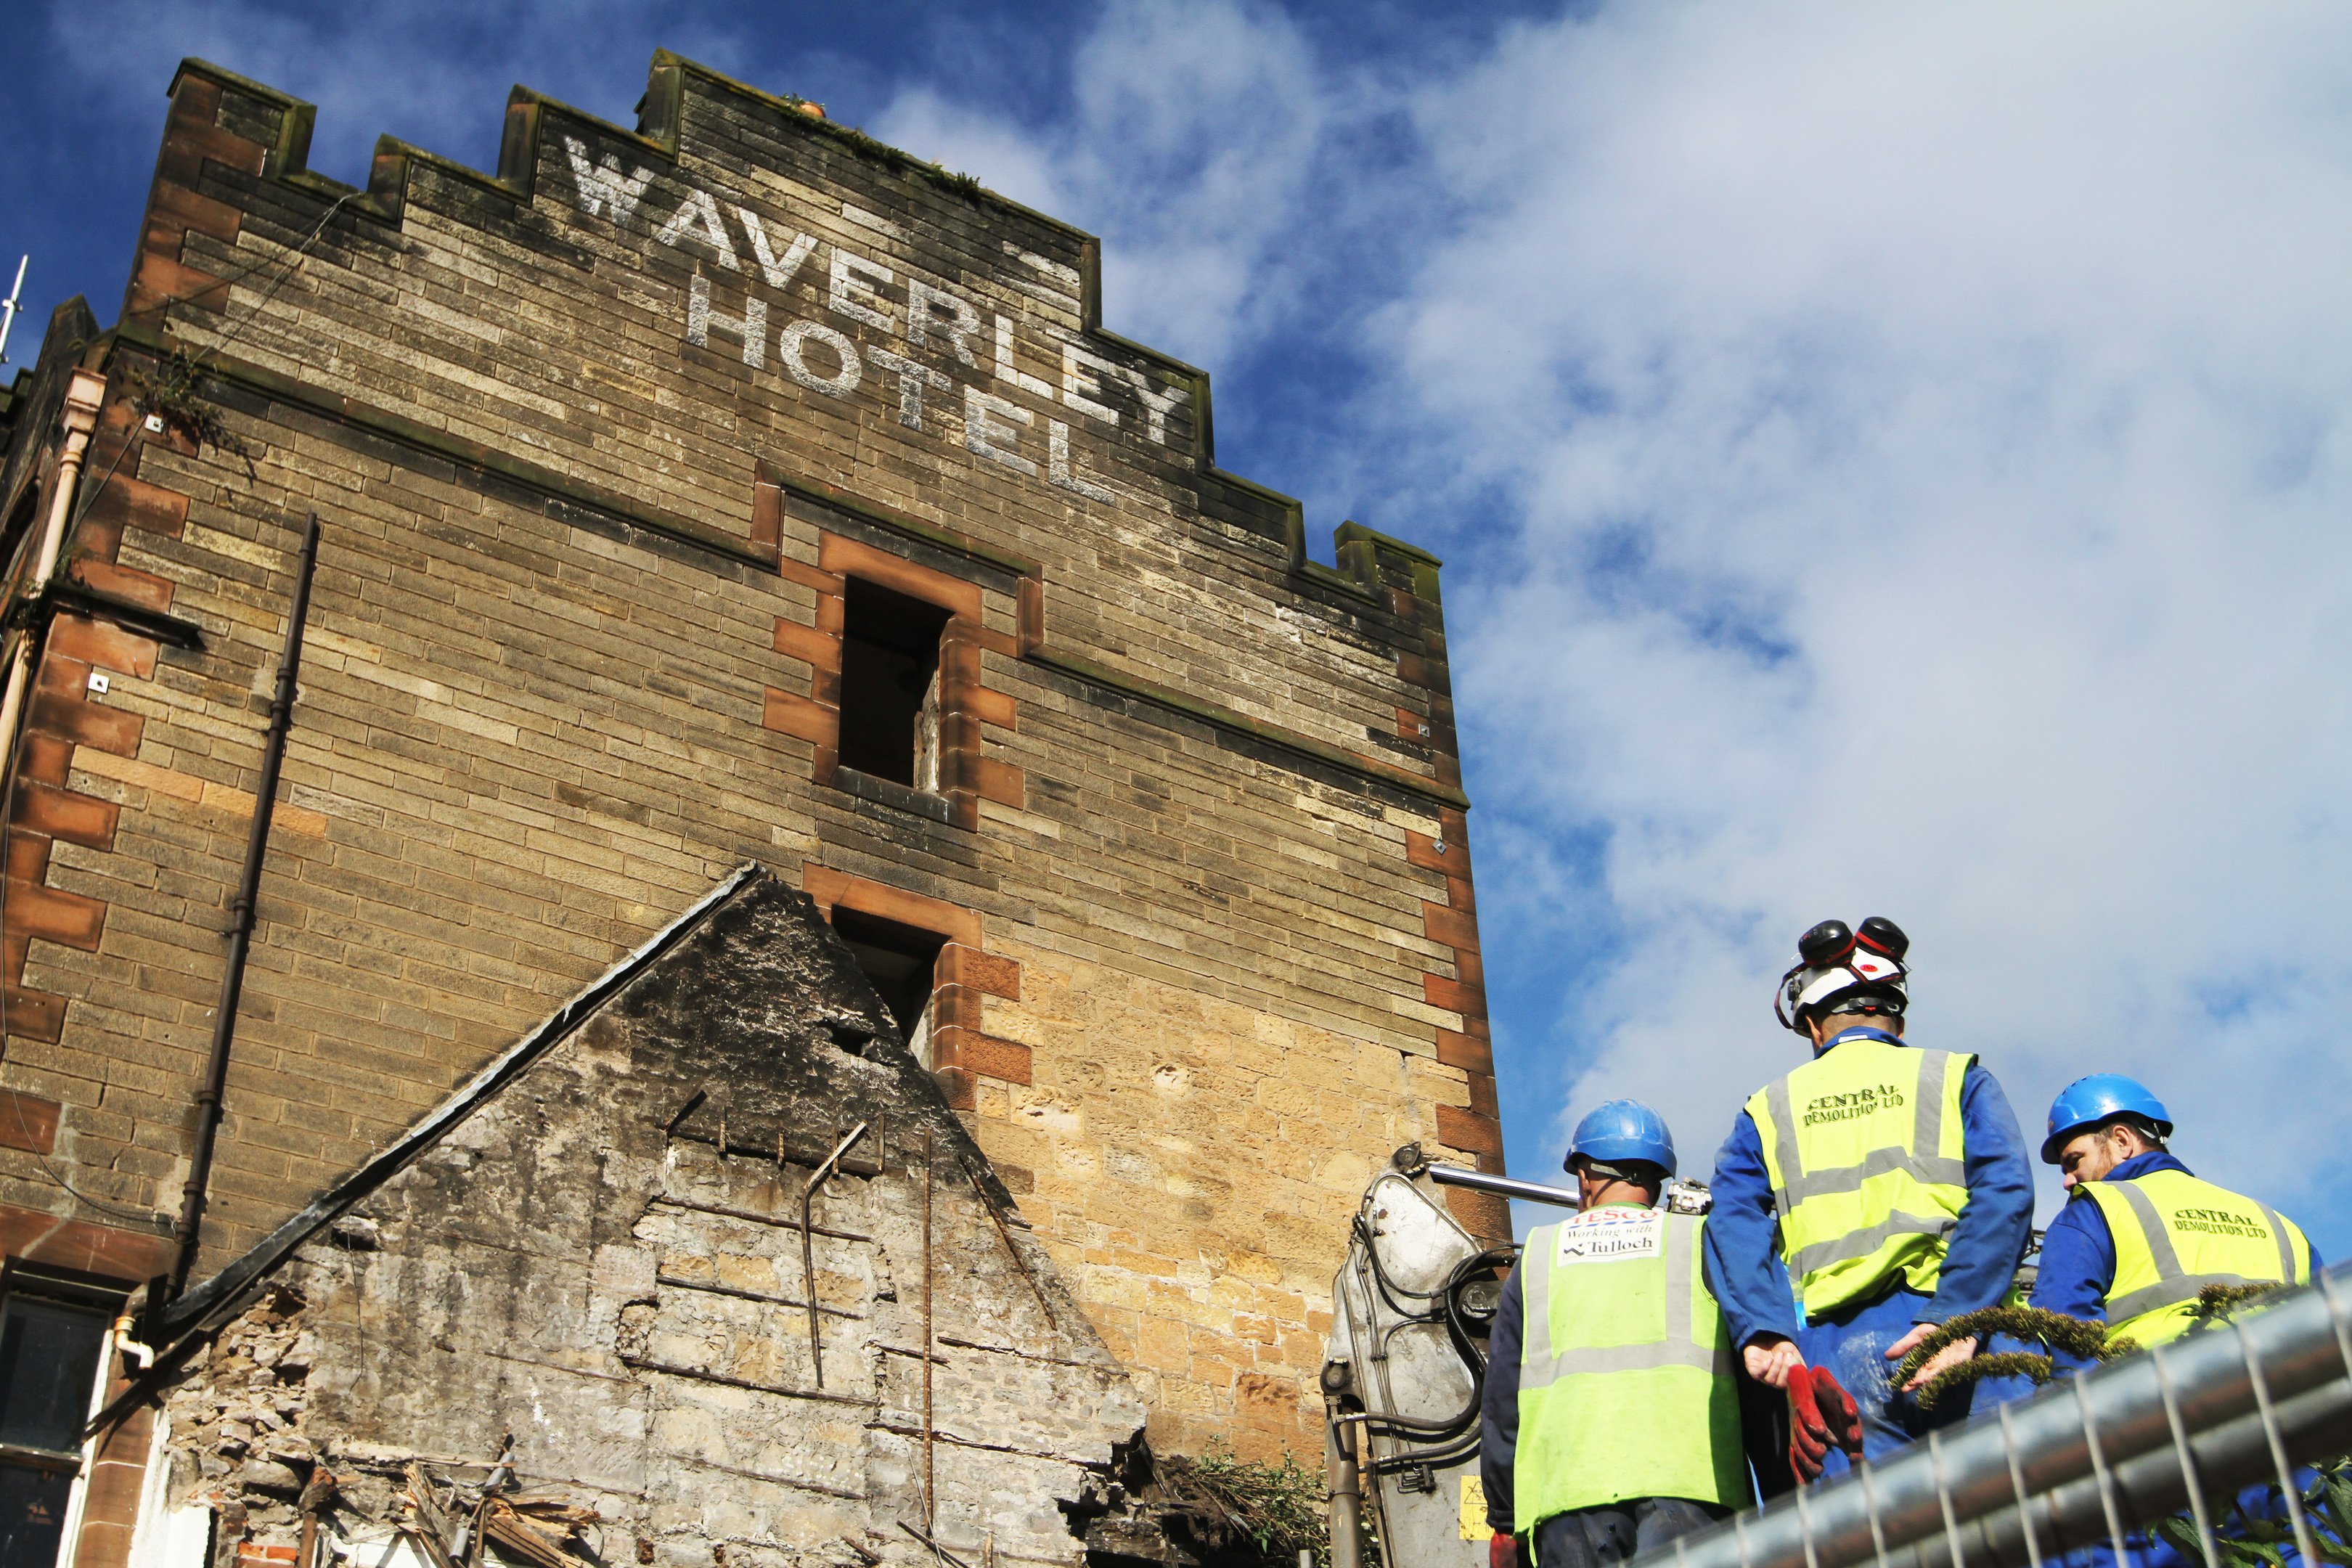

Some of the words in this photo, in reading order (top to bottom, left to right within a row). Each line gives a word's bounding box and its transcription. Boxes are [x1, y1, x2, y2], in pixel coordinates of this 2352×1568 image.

[563, 134, 1193, 445] WAVERLEY
[687, 274, 1116, 507] HOTEL
[1807, 1084, 1899, 1111] CENTRAL
[1573, 1209, 1658, 1224] TESCO
[2174, 1209, 2258, 1227] CENTRAL
[1568, 1228, 1620, 1238] Working
[1626, 1225, 1652, 1233] with
[2174, 1220, 2242, 1236] DEMOLITION
[2245, 1227, 2266, 1239] LTD
[1588, 1237, 1652, 1253] Tulloch
